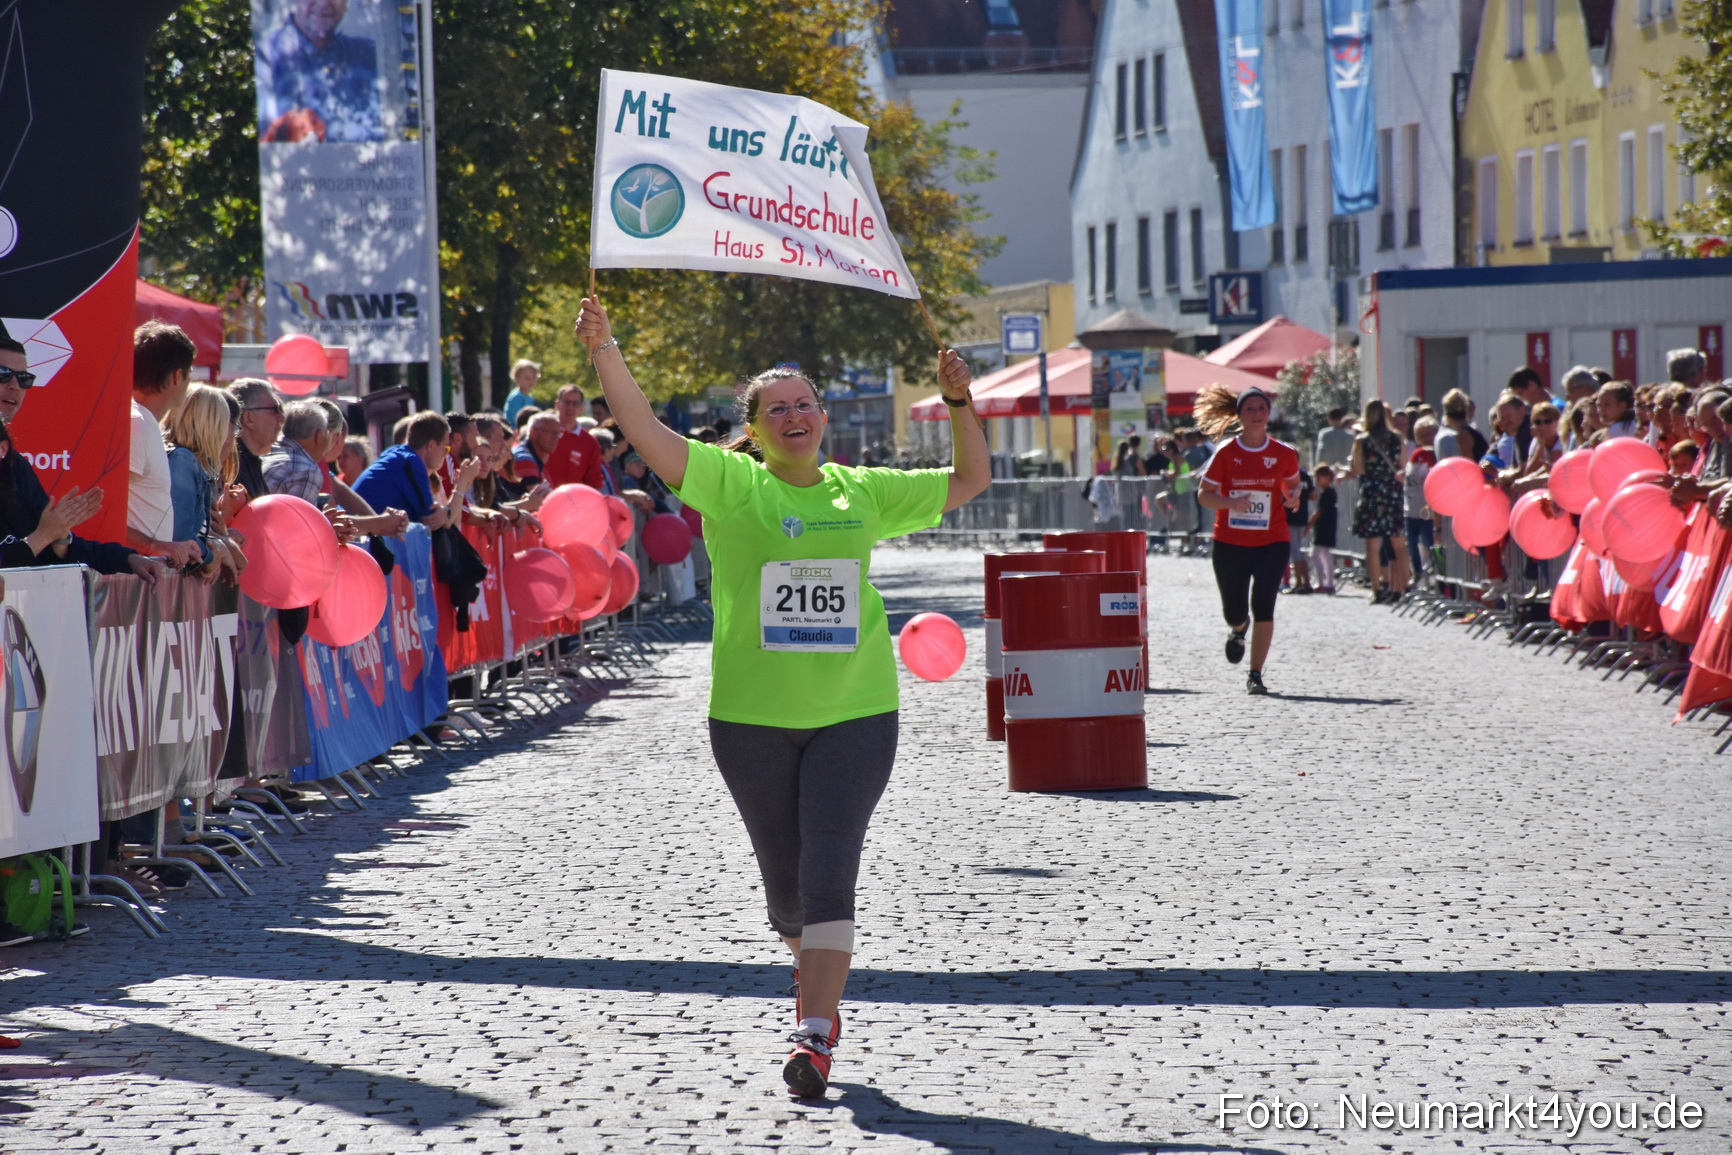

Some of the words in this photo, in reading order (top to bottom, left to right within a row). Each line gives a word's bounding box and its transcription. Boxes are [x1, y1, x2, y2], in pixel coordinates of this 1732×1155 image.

[615, 90, 676, 138] Mit
[708, 126, 766, 156] uns
[703, 171, 875, 241] Grundschule
[715, 231, 764, 259] Haus
[790, 567, 834, 577] BOCK
[776, 584, 845, 613] 2165
[789, 629, 833, 642] Claudia
